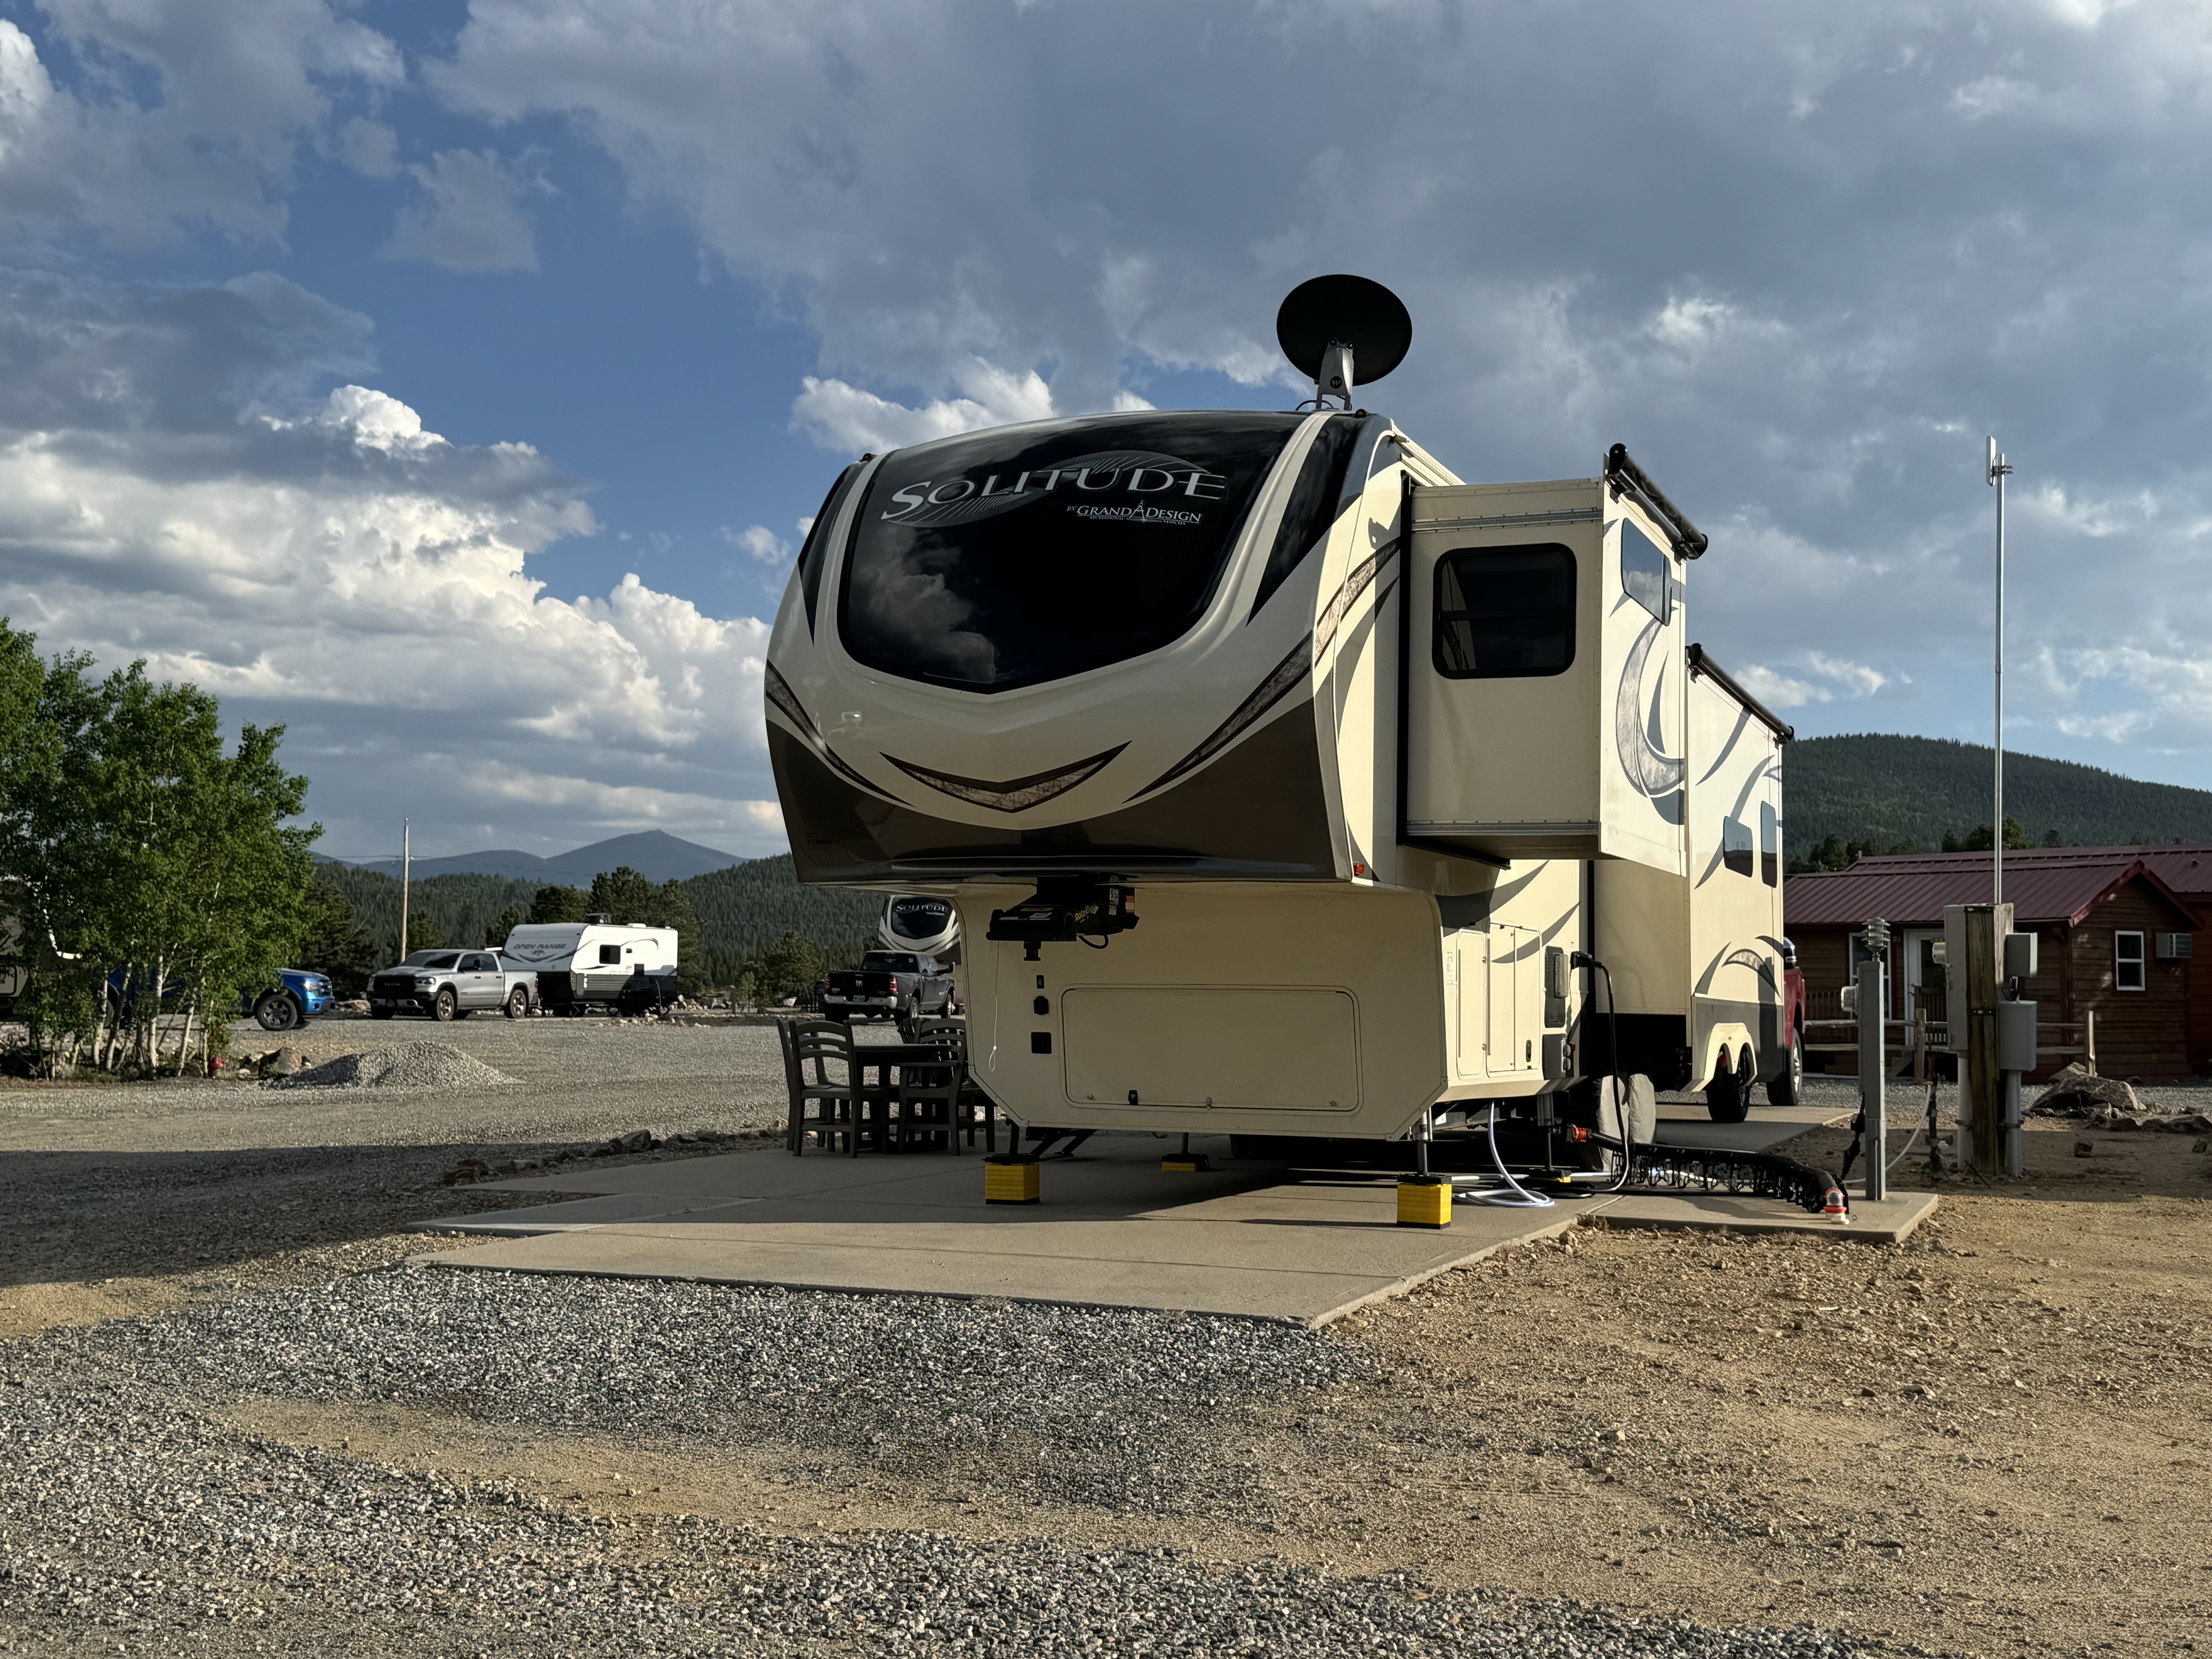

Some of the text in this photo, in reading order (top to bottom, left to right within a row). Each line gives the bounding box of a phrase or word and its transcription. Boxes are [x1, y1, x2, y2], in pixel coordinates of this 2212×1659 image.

[881, 468, 1225, 520] SOLITUDE
[1077, 505, 1132, 516] GRAND
[1146, 507, 1202, 522] DESIGN
